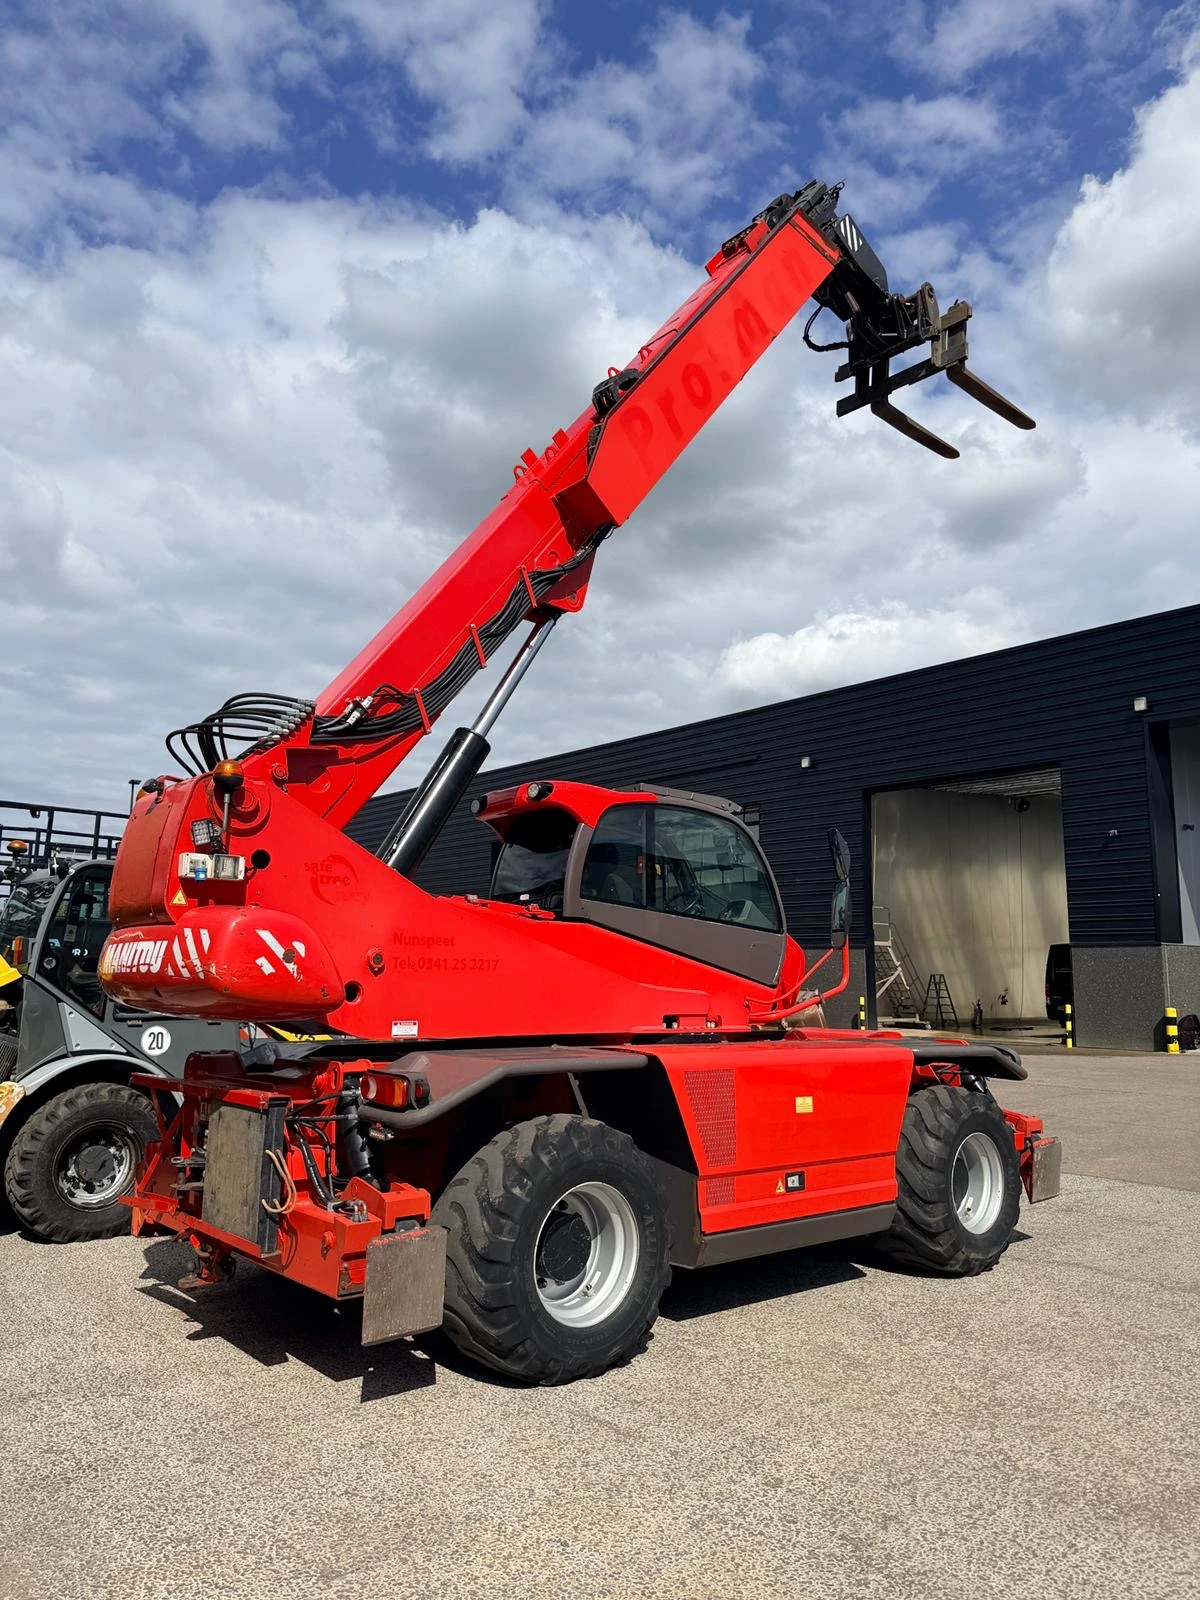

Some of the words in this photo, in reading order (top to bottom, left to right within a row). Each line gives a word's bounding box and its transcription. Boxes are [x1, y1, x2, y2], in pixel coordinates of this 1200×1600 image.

[304, 859, 333, 873] safe
[392, 931, 456, 948] Nunspeet
[102, 940, 168, 974] MANITOU
[417, 957, 448, 971] 0341
[452, 958, 467, 971] 25
[470, 958, 500, 972] 2217
[147, 1031, 165, 1050] 20
